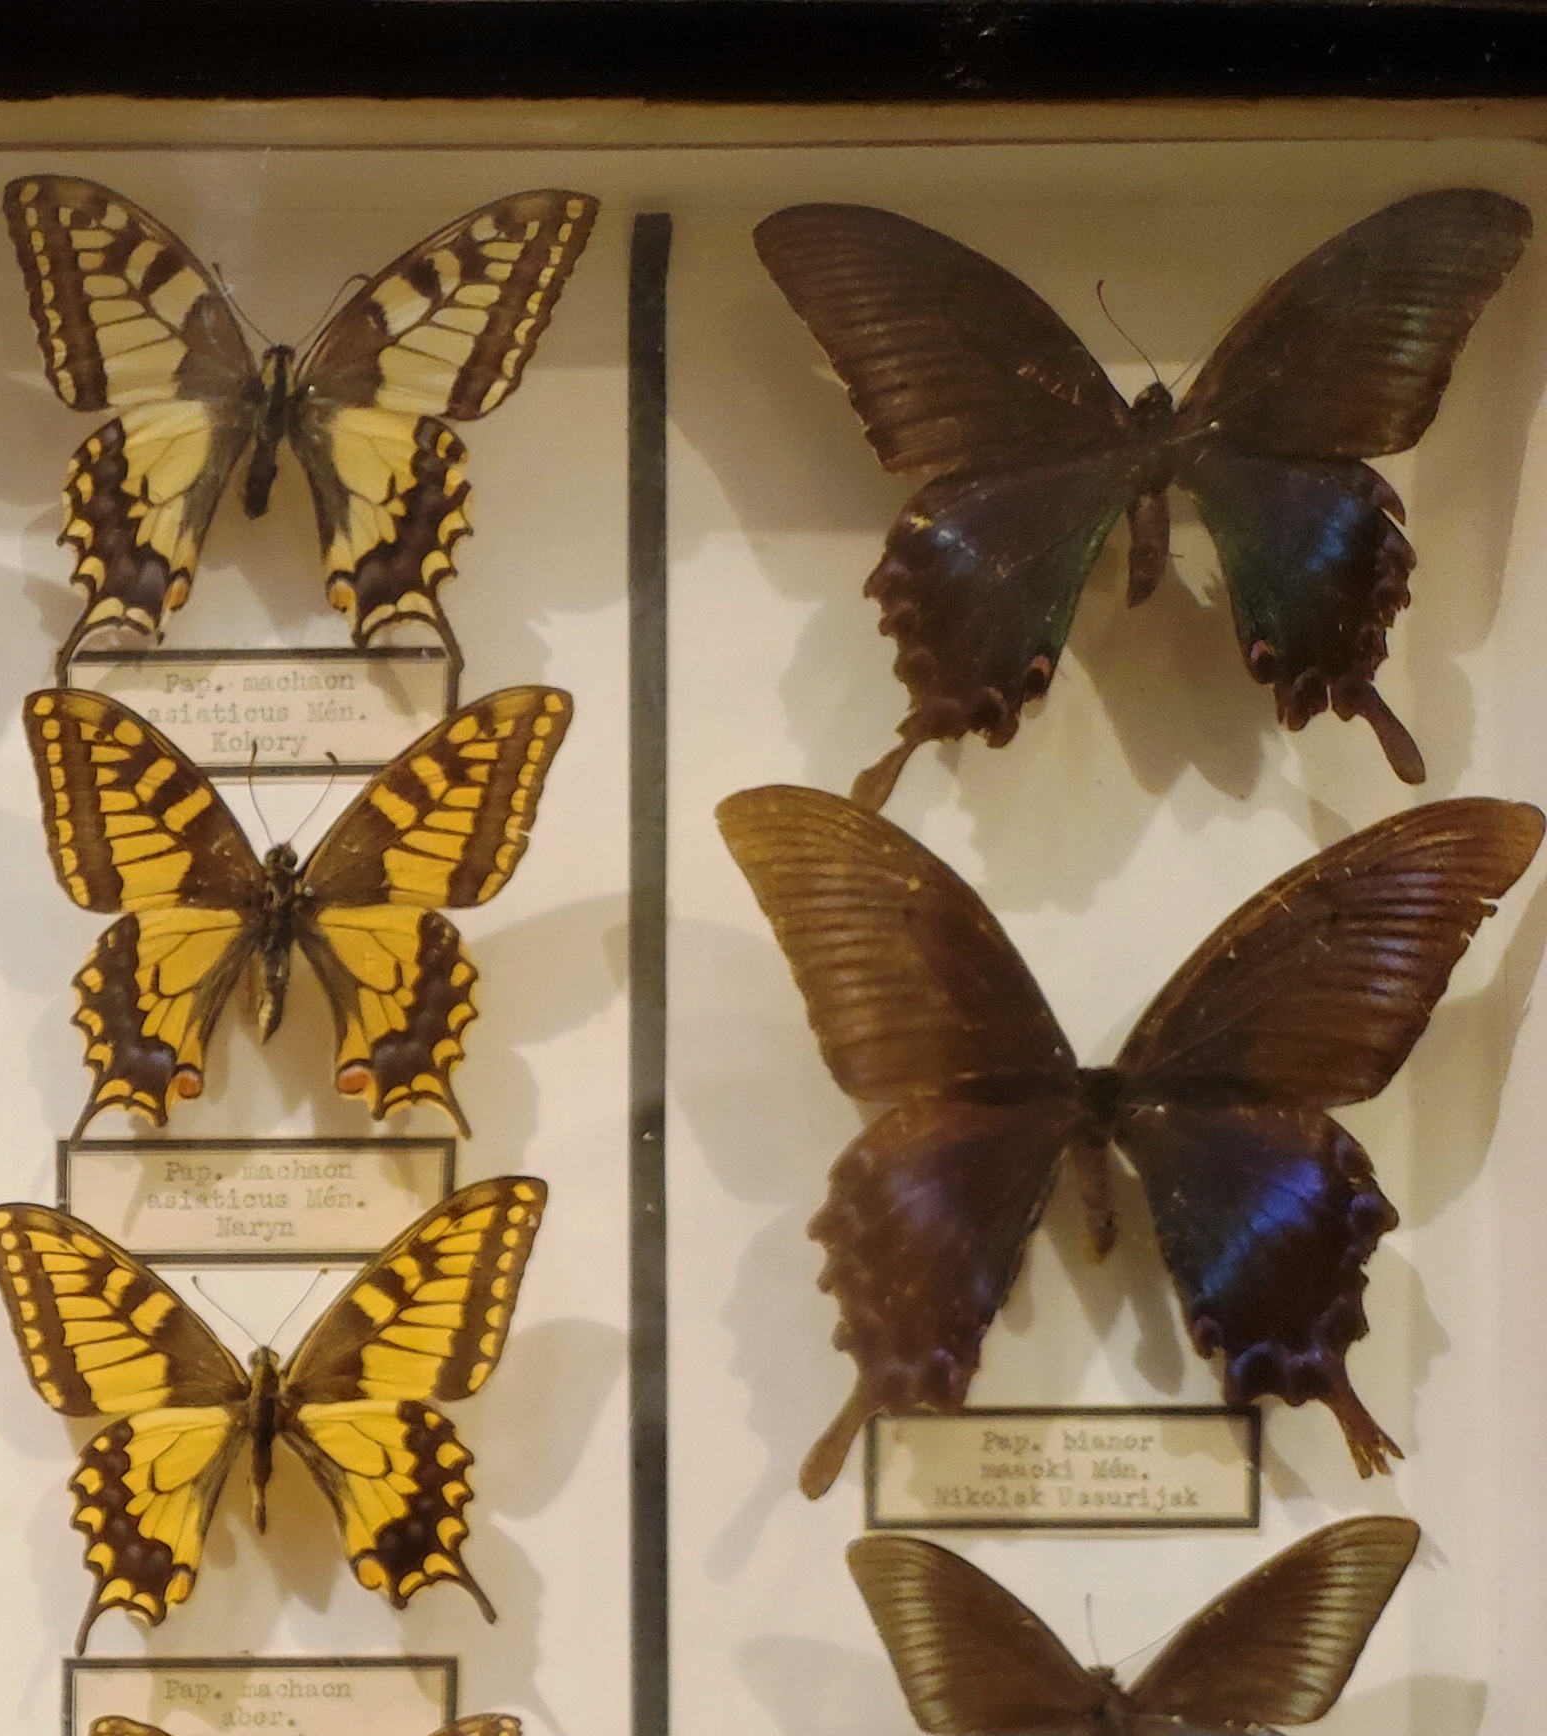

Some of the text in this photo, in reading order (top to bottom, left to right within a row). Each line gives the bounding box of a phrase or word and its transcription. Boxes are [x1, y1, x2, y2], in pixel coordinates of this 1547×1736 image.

[163, 670, 356, 699] Pap. machaon
[147, 698, 367, 725] asiaticus Mén.
[210, 728, 307, 758] Kokory
[163, 1159, 355, 1187] Pap. machaon
[146, 1185, 366, 1212] asiaticus Mén.
[215, 1215, 297, 1242] Naryn
[981, 1427, 1154, 1458] Pap. bianor
[163, 1676, 352, 1705] Pap. machaon
[220, 1705, 297, 1728] aber.
